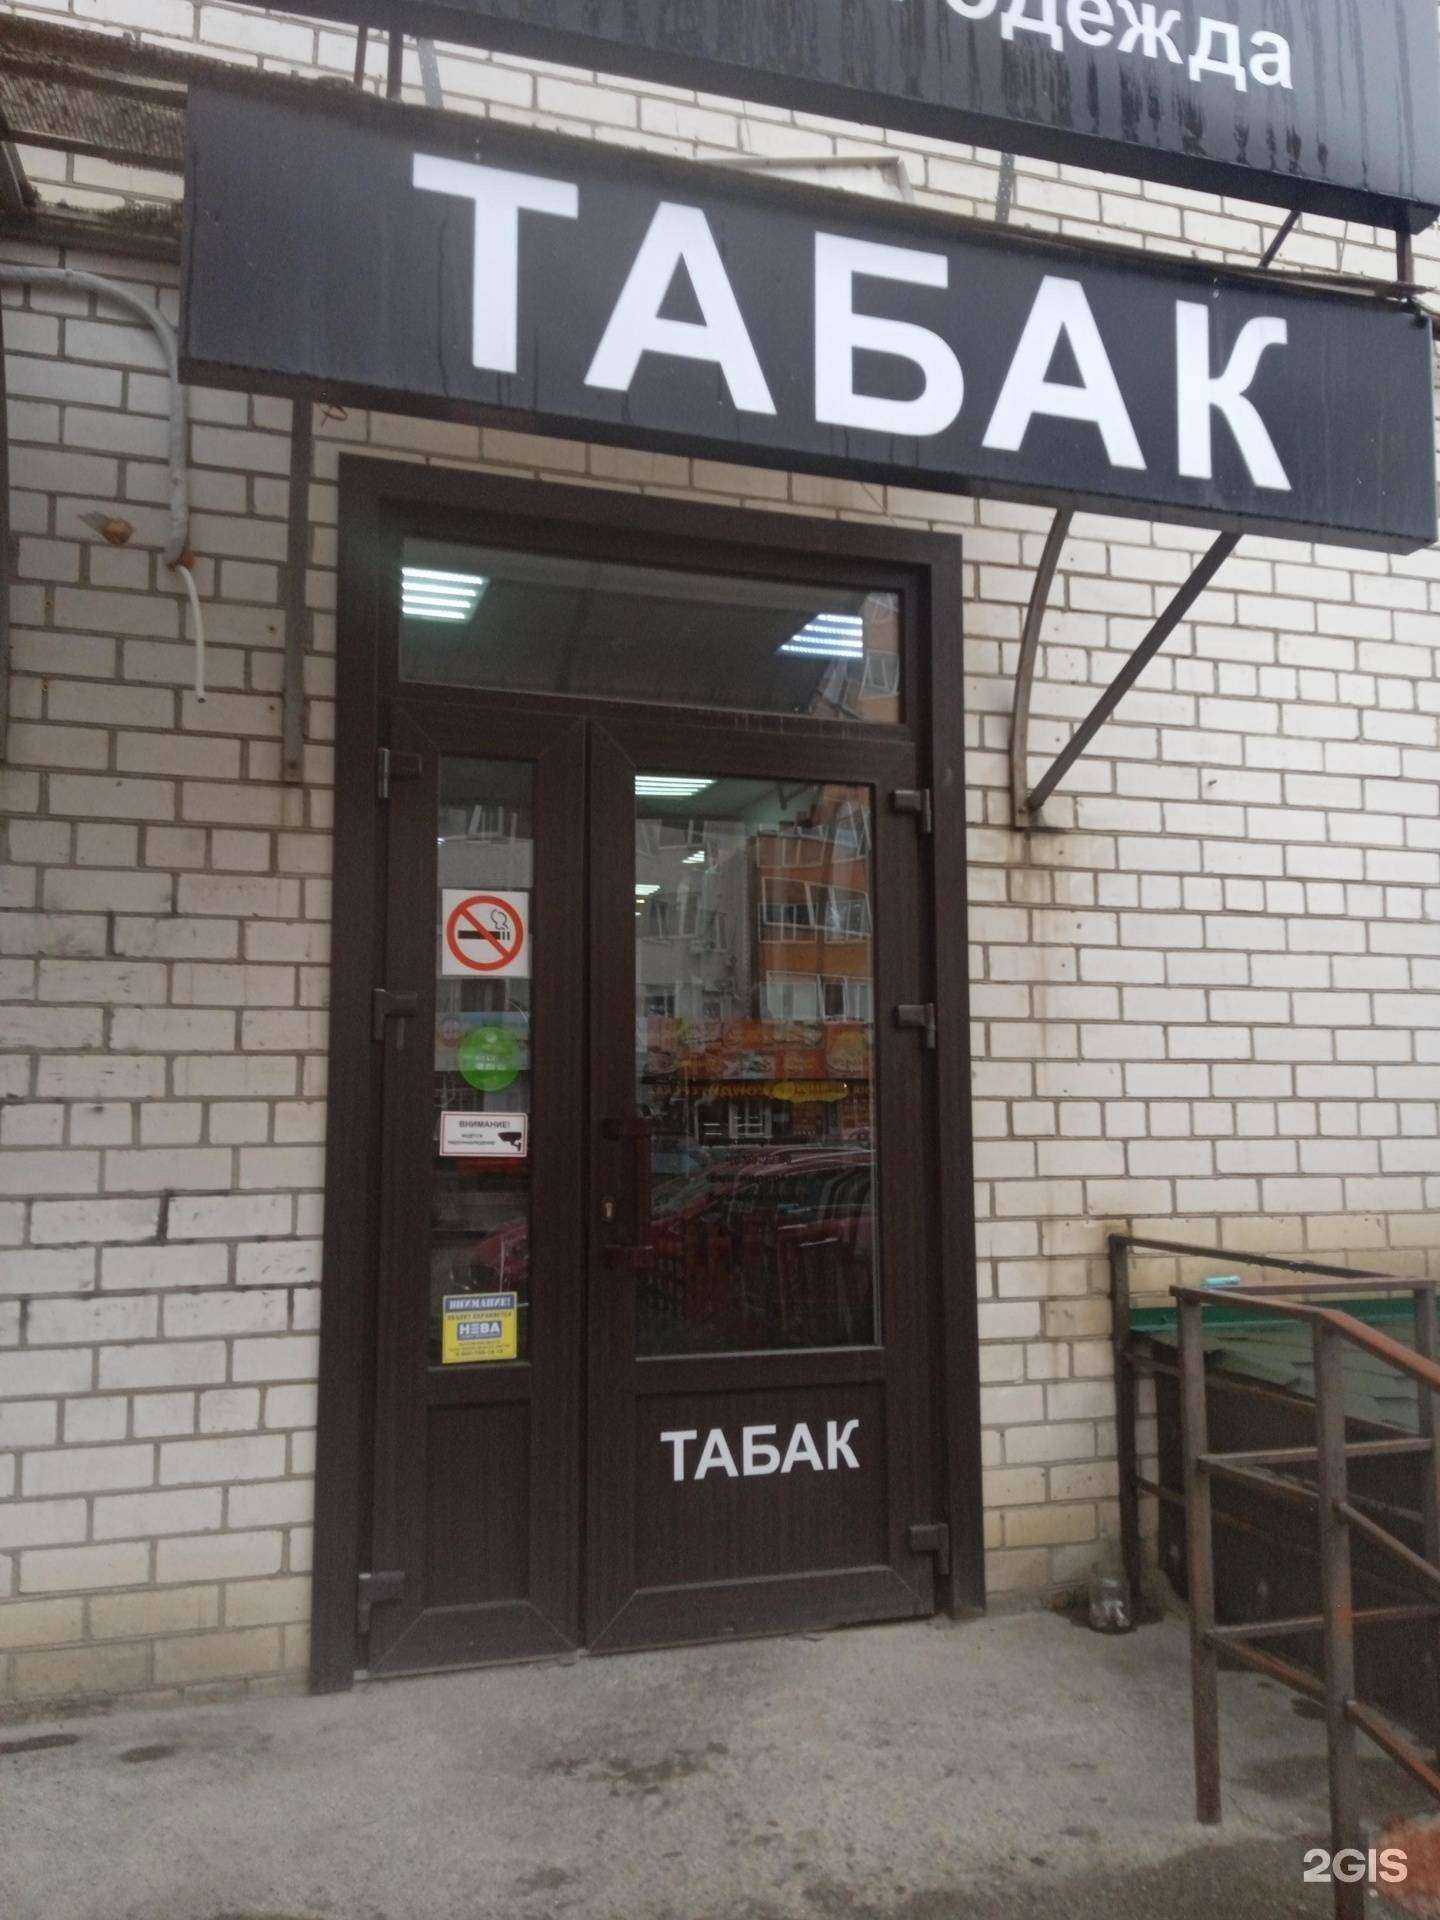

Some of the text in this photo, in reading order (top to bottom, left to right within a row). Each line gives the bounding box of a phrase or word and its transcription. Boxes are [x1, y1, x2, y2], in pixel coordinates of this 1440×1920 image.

[412, 152, 1292, 491] ТАБАК
[459, 1120, 510, 1129] ВНИМАНИЕ!
[460, 1322, 501, 1335] НЕВА
[660, 1419, 860, 1482] ТАБАК
